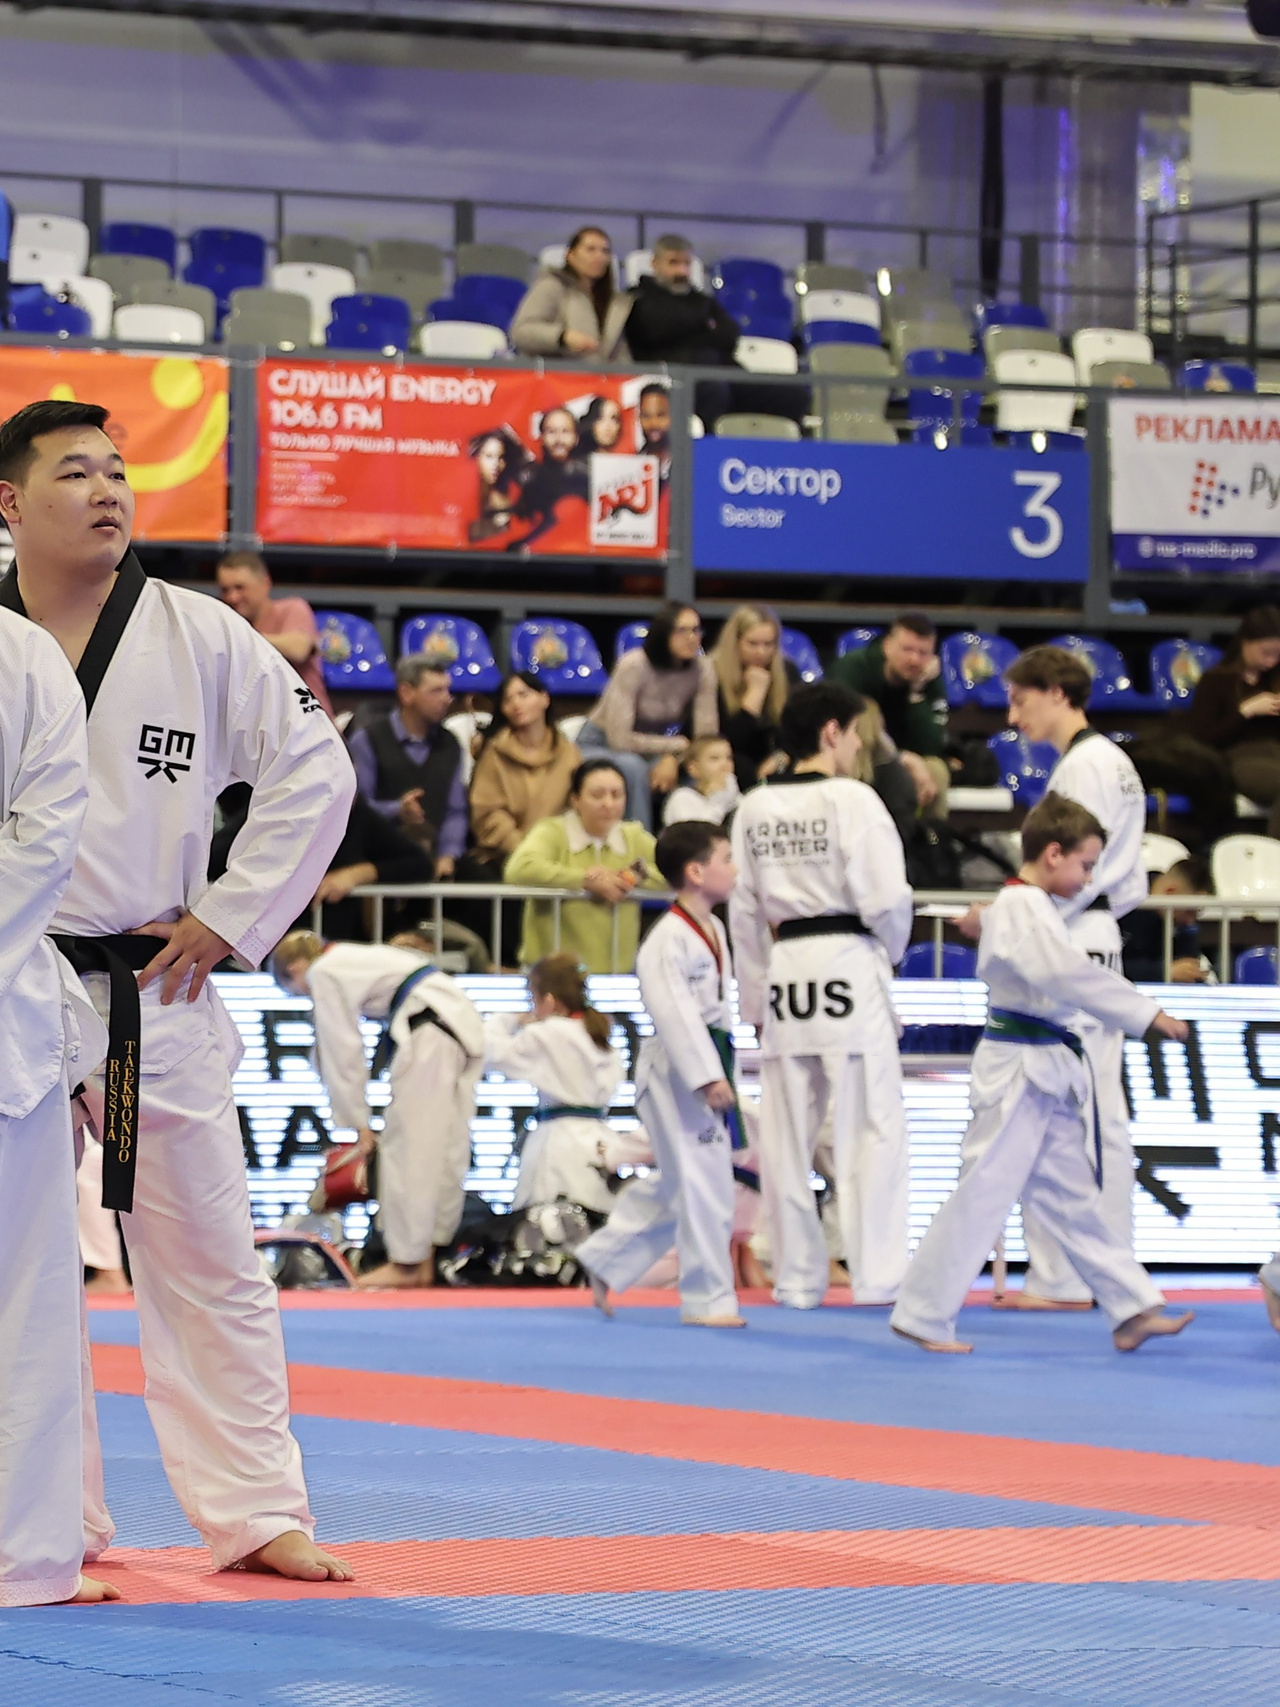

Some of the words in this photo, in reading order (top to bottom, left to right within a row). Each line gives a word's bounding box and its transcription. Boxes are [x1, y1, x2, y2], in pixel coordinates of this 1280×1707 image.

[268, 367, 386, 400] СЛУШАЙ
[392, 375, 497, 406] ENERGY
[270, 400, 338, 428] 106.6
[343, 404, 382, 431] FM
[1135, 414, 1280, 444] РЕКЛАМА
[721, 457, 842, 502] Сектор
[1009, 470, 1065, 559] 3
[721, 504, 786, 528] Sector
[106, 1059, 120, 1141] RUSSIA
[118, 1040, 136, 1163] TAEKWONDO
